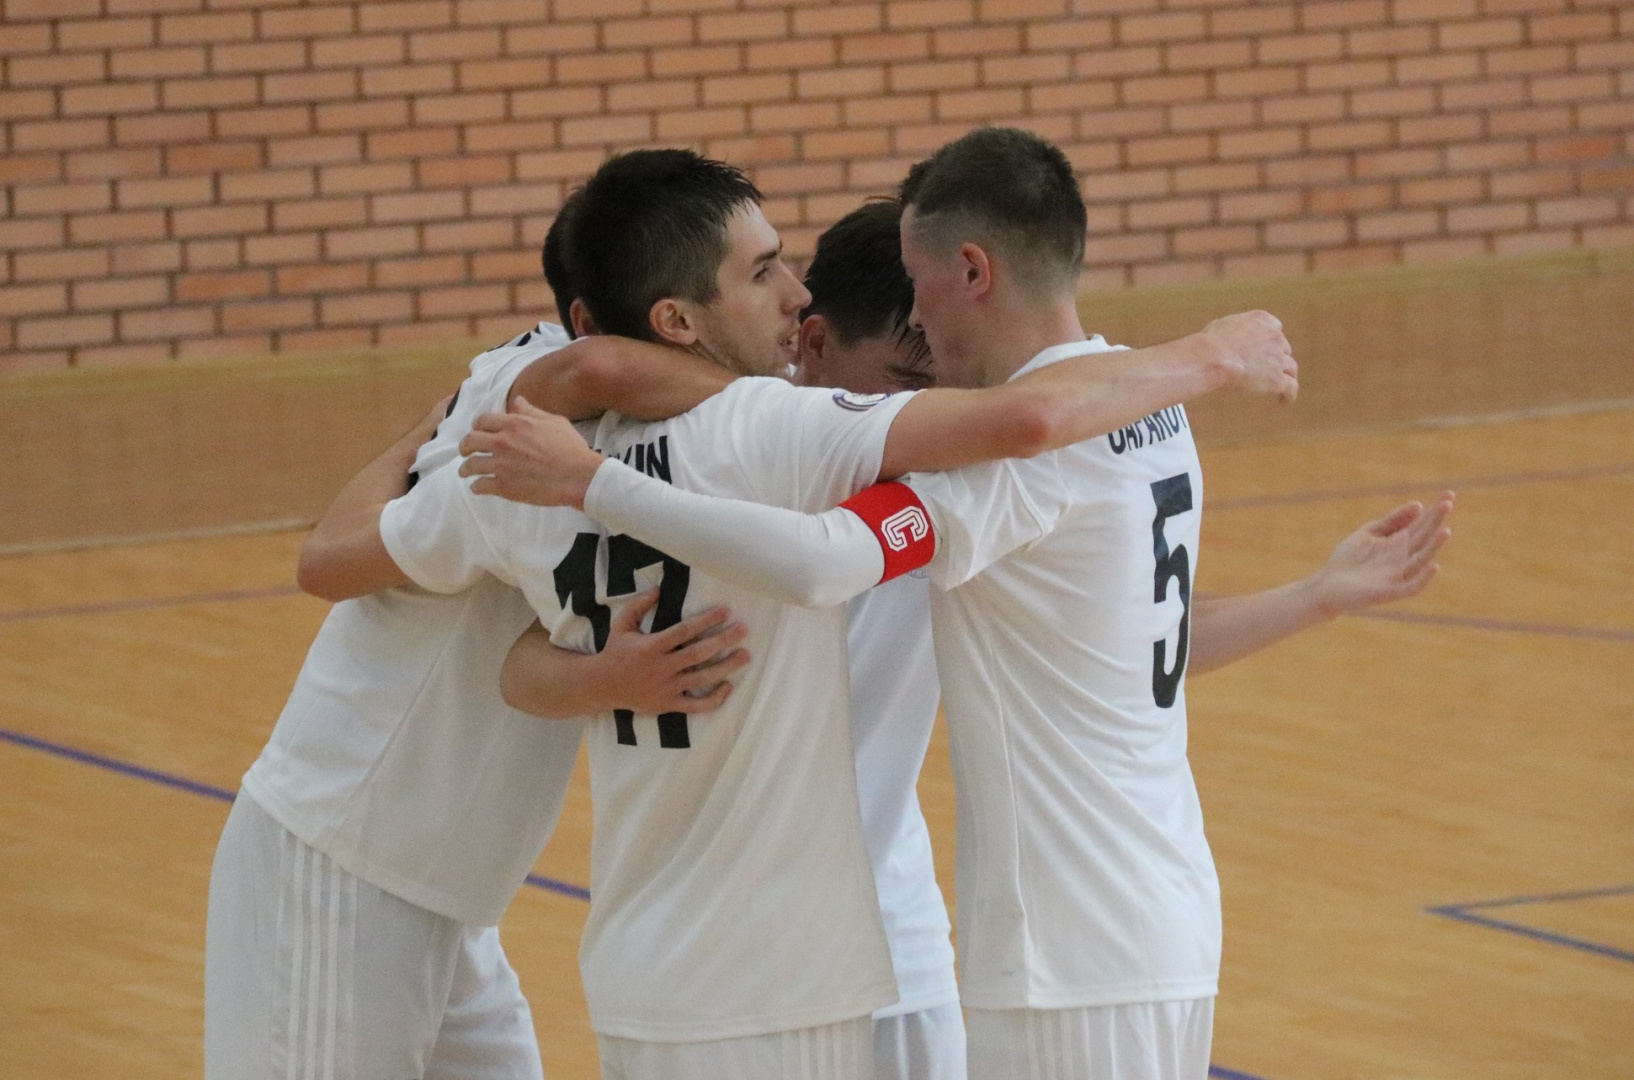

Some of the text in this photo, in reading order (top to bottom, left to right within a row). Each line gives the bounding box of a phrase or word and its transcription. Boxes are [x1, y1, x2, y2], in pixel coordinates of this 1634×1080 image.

[881, 505, 929, 552] C
[1150, 472, 1193, 709] 5
[553, 532, 691, 749] 17
